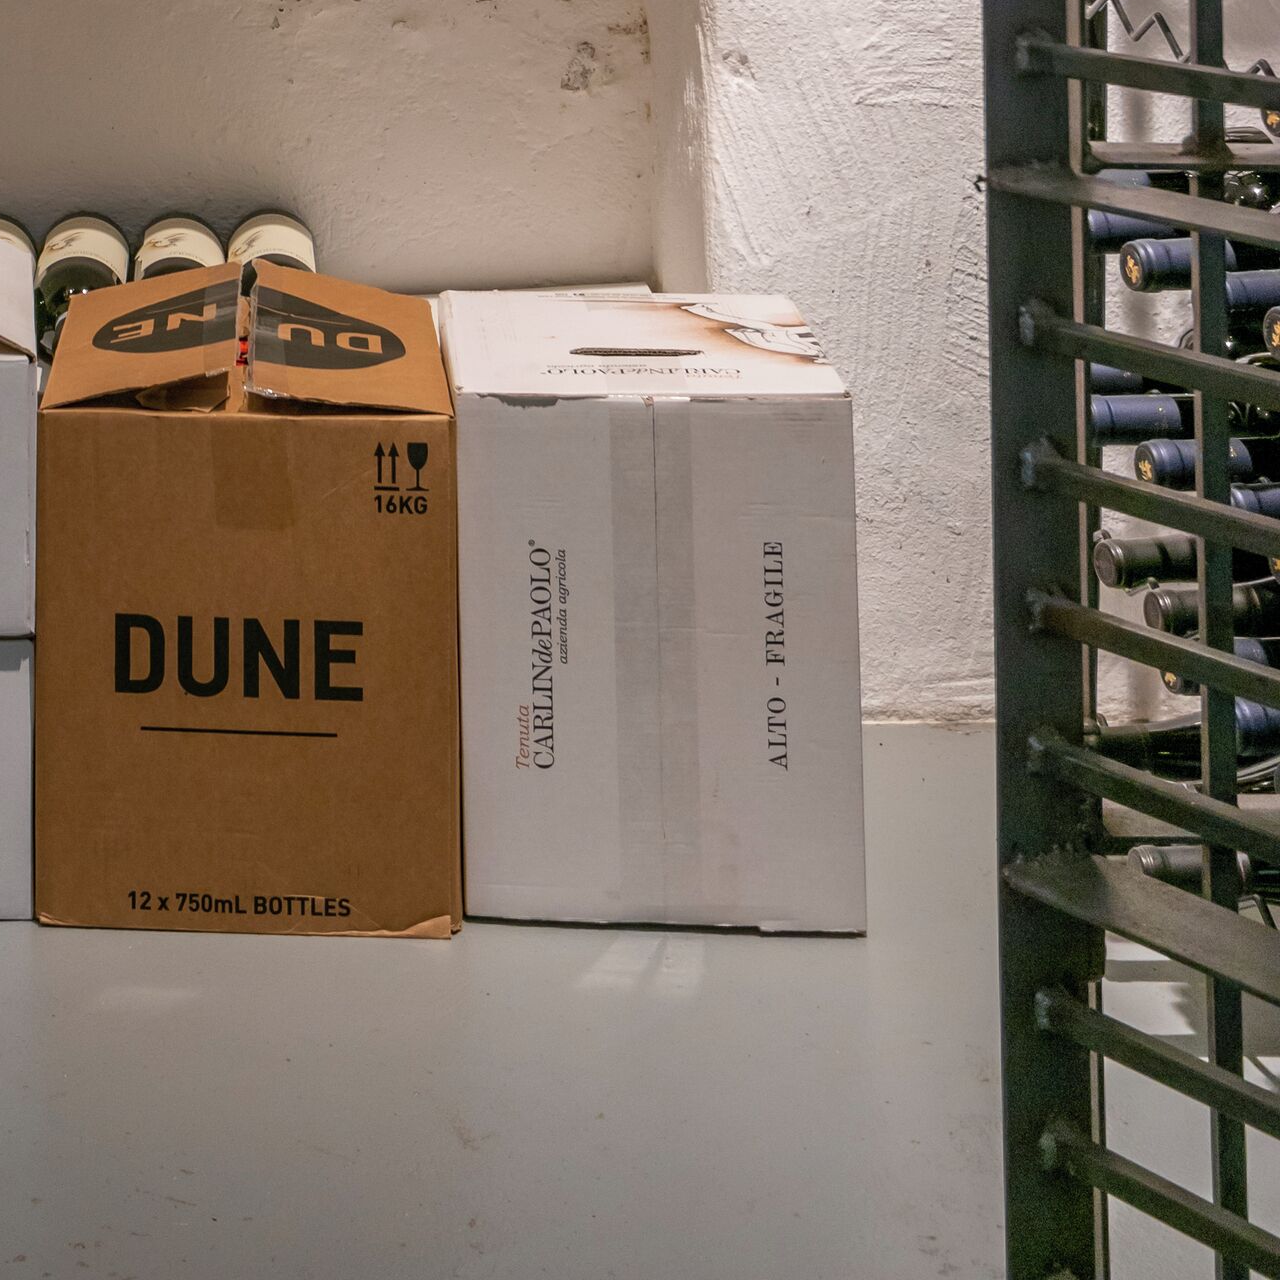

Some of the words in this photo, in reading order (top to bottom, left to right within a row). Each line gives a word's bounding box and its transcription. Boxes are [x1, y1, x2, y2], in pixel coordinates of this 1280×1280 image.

[374, 495, 428, 515] 16KG
[557, 548, 570, 605] agricola
[763, 541, 786, 667] FRAGILE
[114, 613, 364, 701] DUNE
[559, 607, 569, 665] azienda
[515, 704, 530, 769] Tenuta
[766, 696, 788, 771] ALTO
[127, 891, 152, 911] 12
[157, 896, 170, 911] x
[176, 892, 247, 915] 750mL
[253, 895, 351, 917] BOTTLES
